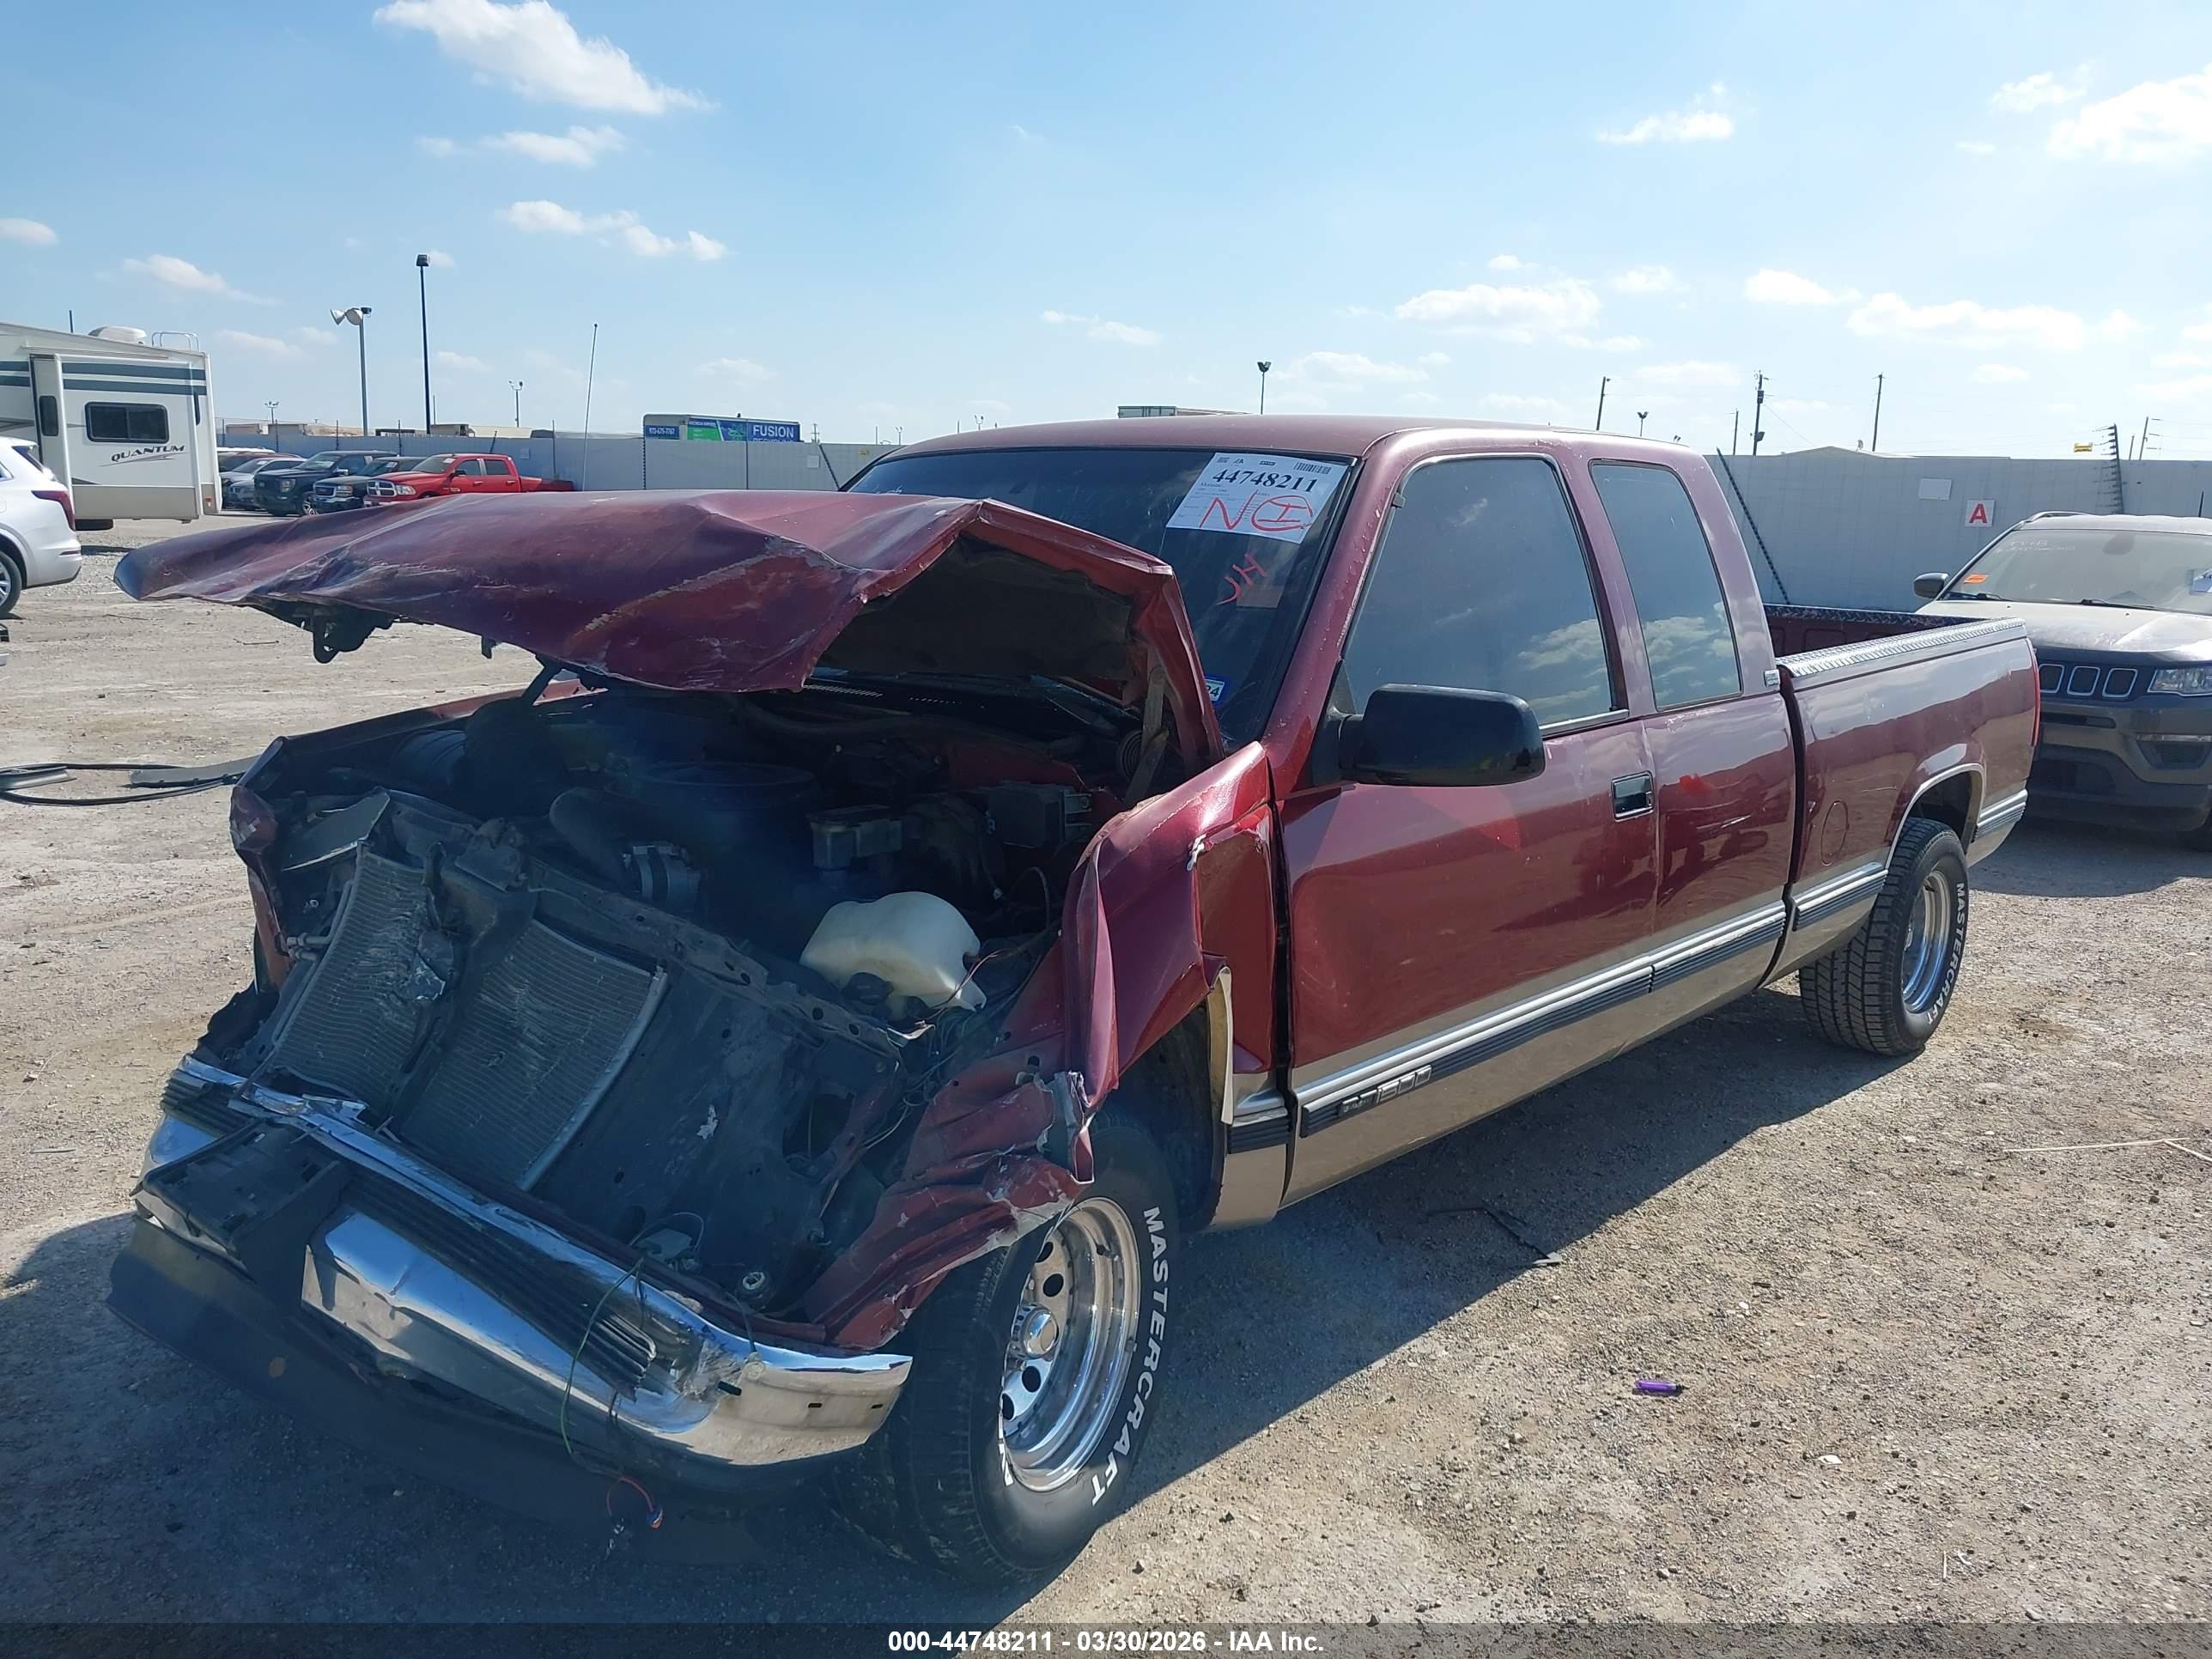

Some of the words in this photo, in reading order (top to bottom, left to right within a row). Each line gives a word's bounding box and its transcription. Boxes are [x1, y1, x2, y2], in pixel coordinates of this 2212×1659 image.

[753, 424, 794, 438] FUSION
[111, 445, 185, 462] QUANTUM
[1212, 468, 1318, 494] 44748211
[1969, 503, 1988, 524] A
[1927, 882, 1966, 1025] MASTERCRAFT
[1091, 1206, 1169, 1507] MASTERCRAFT
